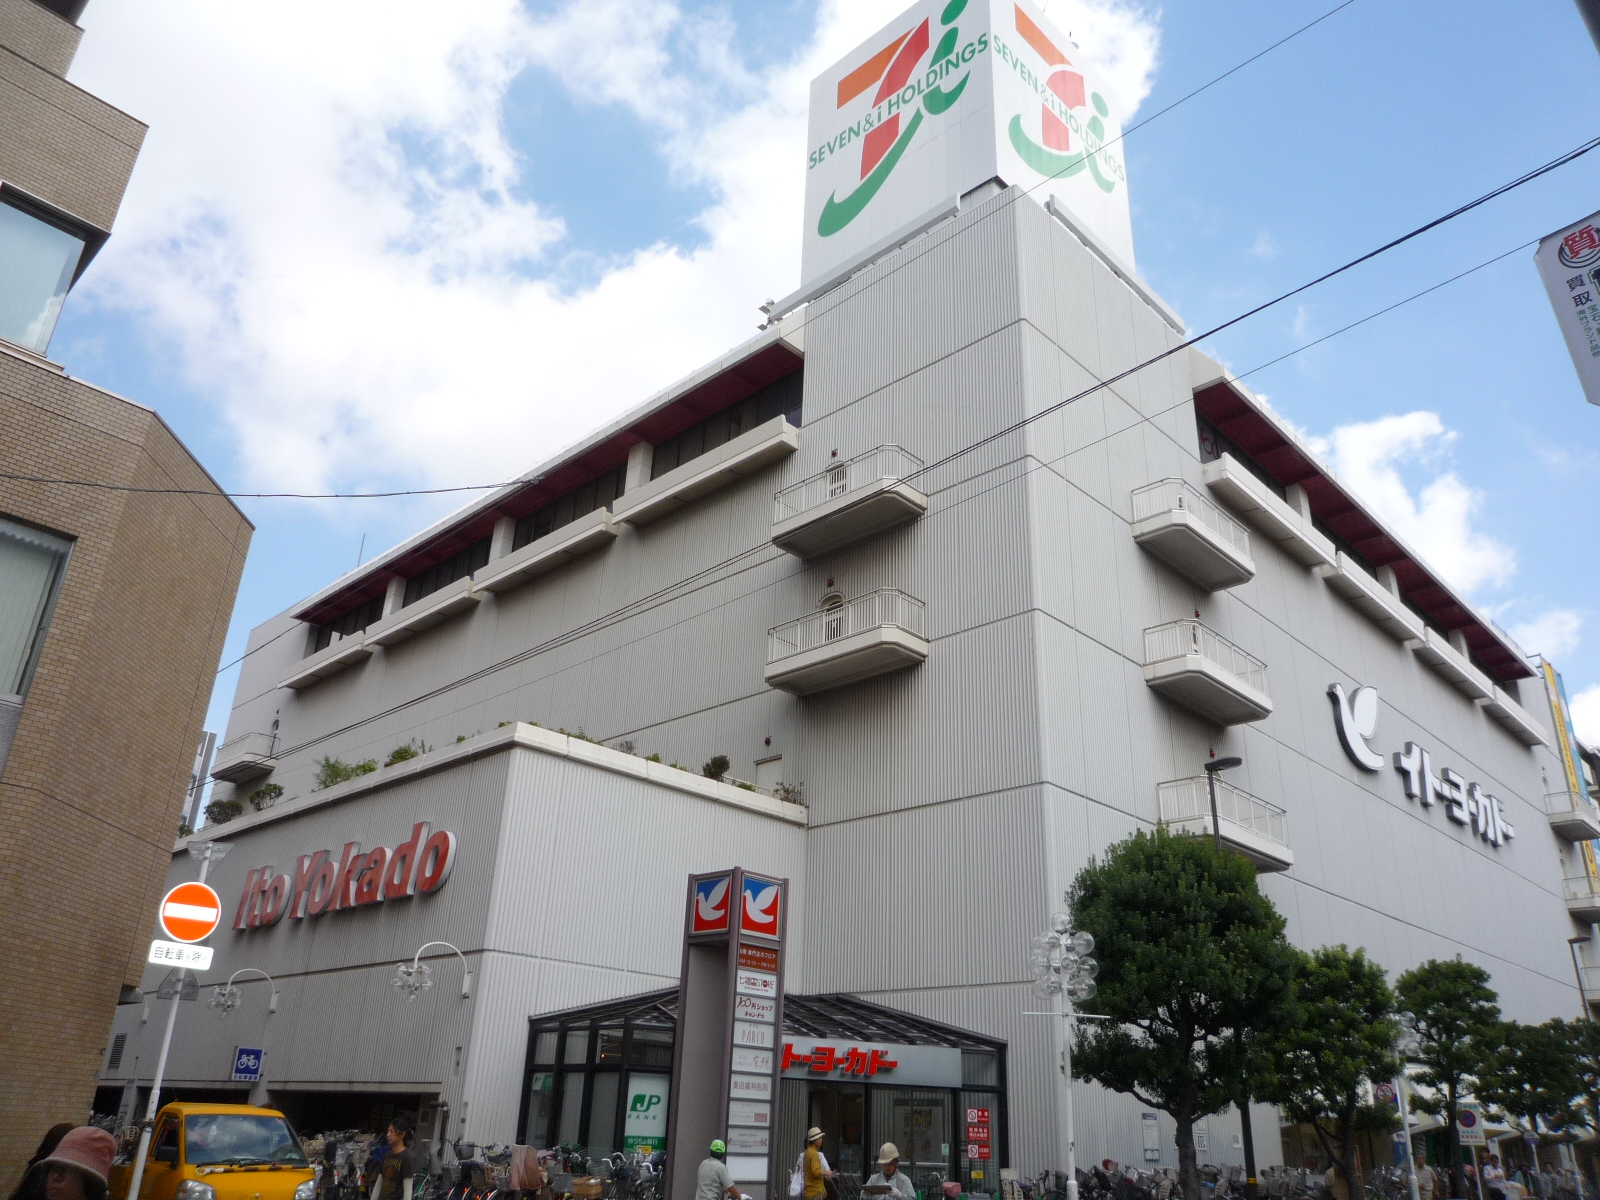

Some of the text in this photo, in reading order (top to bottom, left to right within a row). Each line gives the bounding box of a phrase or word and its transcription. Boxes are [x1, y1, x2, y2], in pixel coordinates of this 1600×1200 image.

[808, 127, 862, 171] SEVEN
[887, 32, 989, 117] HOLDINGS
[993, 33, 1039, 94] SEVEN
[1060, 105, 1125, 183] HOLDINGS
[1393, 741, 1514, 847] イトーヨーカドー
[232, 821, 457, 931] Ito Yokado
[742, 1030, 765, 1044] PARCO
[630, 1093, 661, 1112] JP
